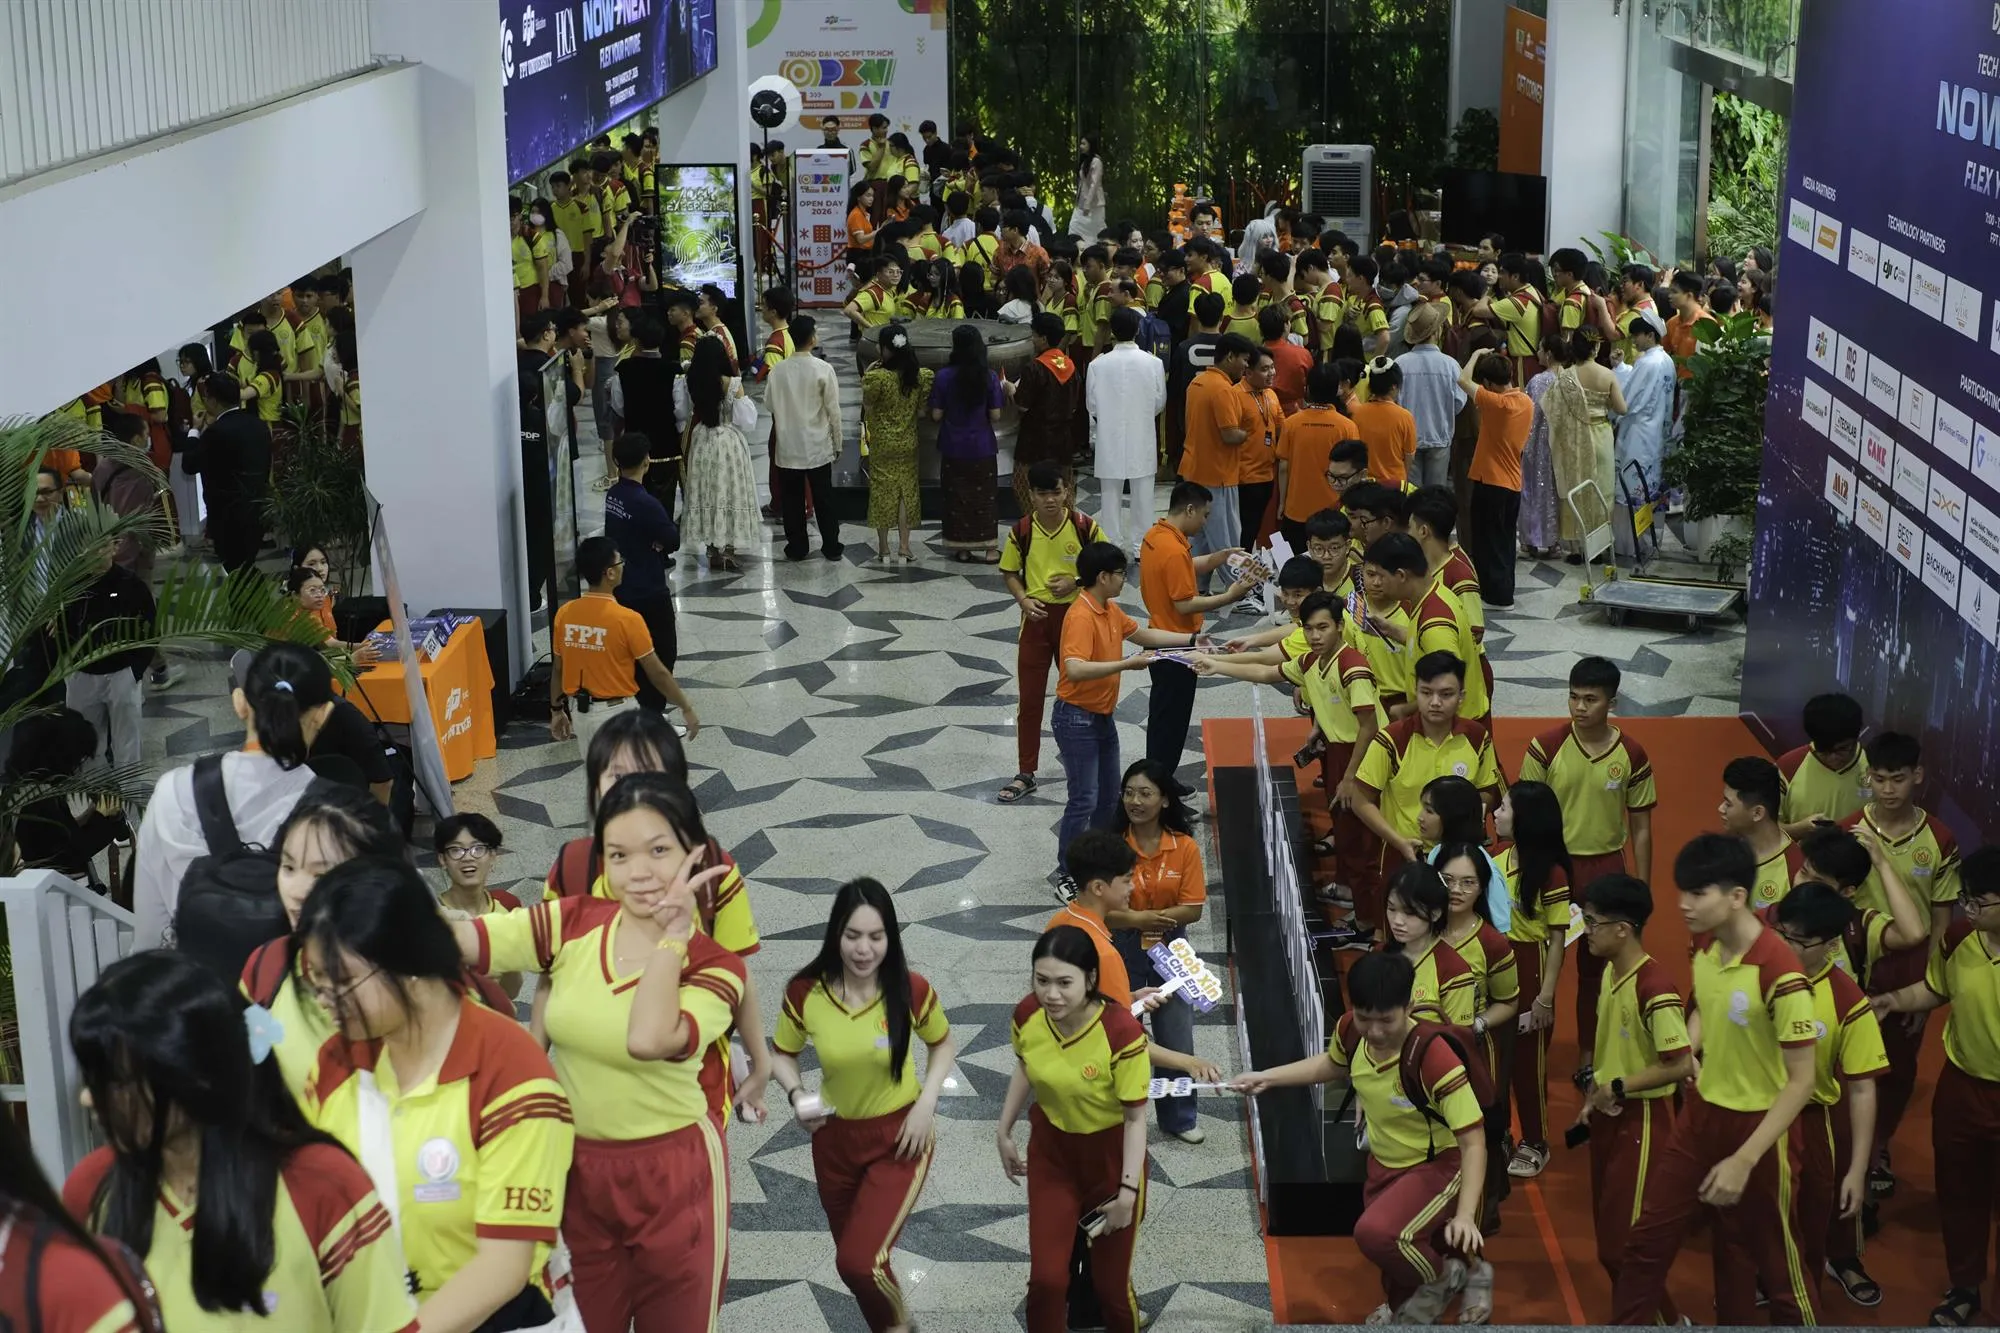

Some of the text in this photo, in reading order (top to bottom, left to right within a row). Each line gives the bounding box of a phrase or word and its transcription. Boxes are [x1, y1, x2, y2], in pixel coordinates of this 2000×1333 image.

[555, 7, 577, 59] HCA
[1978, 53, 2000, 78] TECH
[840, 91, 890, 109] DAY
[1963, 160, 1994, 196] FLEX
[1887, 214, 1946, 255] TECHNOLOGY PARTNERS
[1867, 437, 1887, 468] CAKE
[1897, 522, 1913, 547] BEST
[564, 624, 607, 646] FPT
[1171, 942, 1202, 975] #Job
[1197, 973, 1220, 1000] Xin
[1183, 978, 1201, 996] Em
